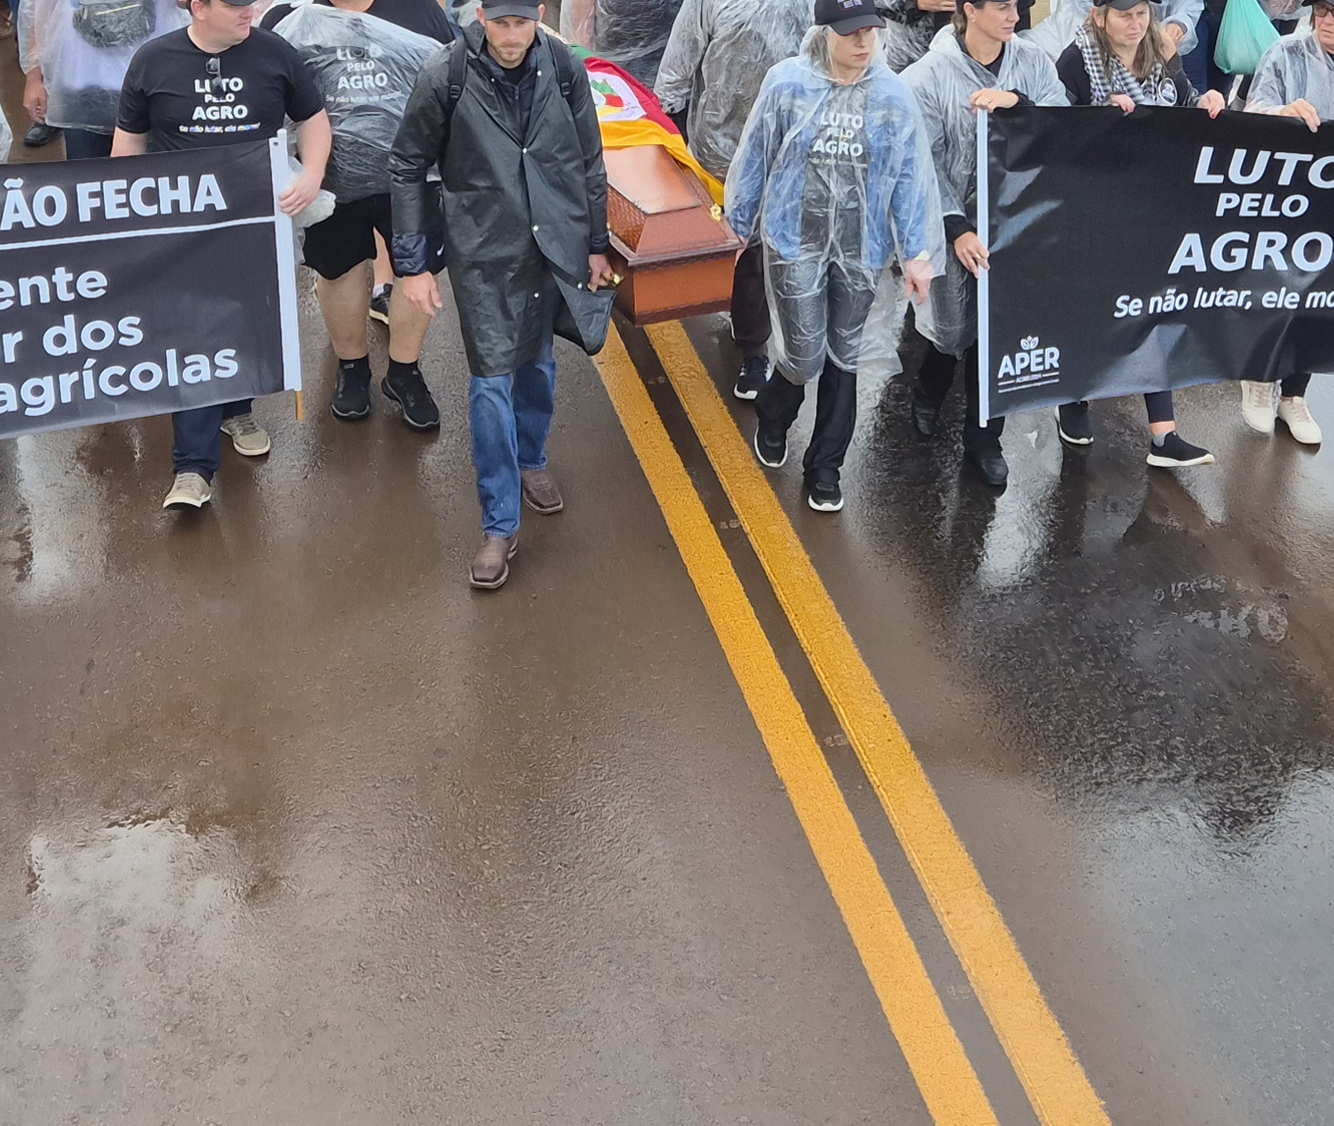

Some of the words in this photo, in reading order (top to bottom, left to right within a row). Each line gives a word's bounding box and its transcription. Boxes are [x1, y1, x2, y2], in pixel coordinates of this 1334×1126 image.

[347, 60, 375, 72] PELO
[337, 72, 388, 89] AGRO
[192, 104, 248, 121] AGRO
[819, 112, 864, 130] LUTO
[826, 126, 855, 139] PELO
[812, 140, 864, 158] AGRO
[76, 173, 228, 223] FECHA
[1214, 192, 1310, 218] PELO
[1167, 230, 1334, 275] AGRO
[1113, 294, 1144, 319] Se
[1148, 287, 1189, 315] não
[1192, 286, 1253, 311] lutar,
[1261, 286, 1300, 309] ele
[42, 314, 144, 358] dos
[997, 346, 1060, 379] APER
